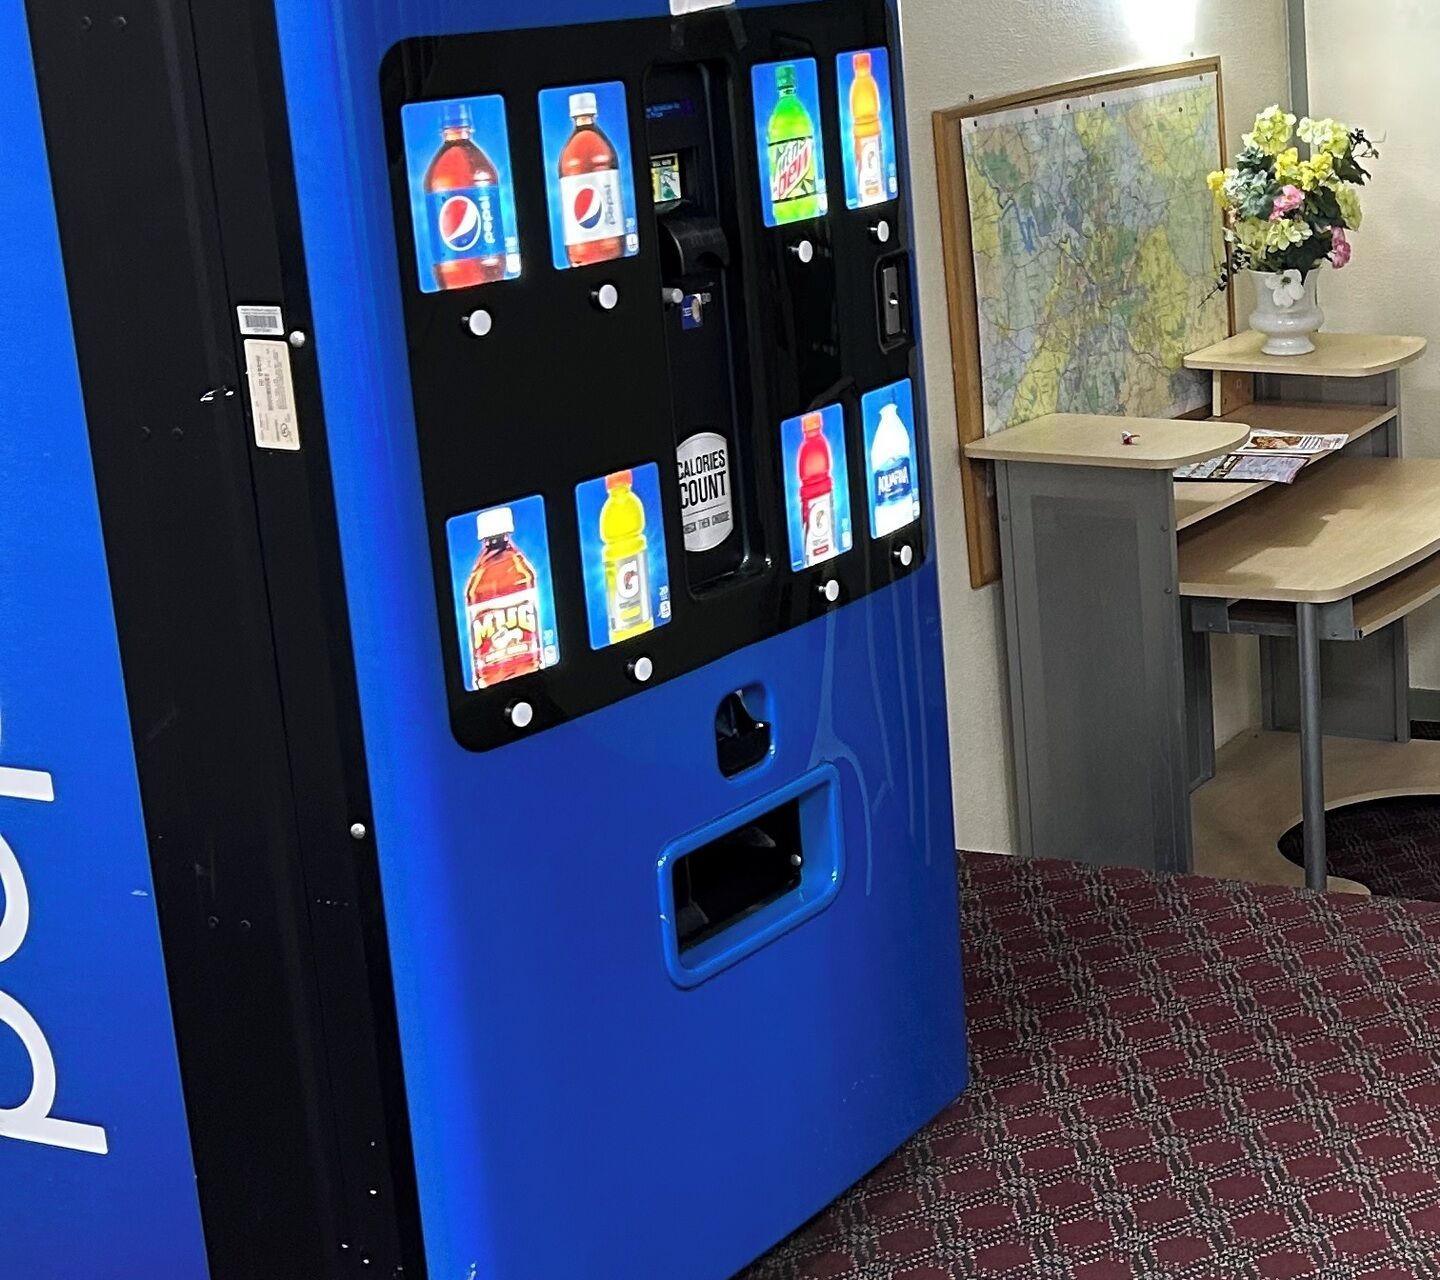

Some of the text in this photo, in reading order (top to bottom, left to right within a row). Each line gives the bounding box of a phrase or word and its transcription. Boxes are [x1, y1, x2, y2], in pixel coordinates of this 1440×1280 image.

[478, 195, 496, 244] pepsi
[678, 449, 726, 481] CALORIES
[680, 470, 727, 509] COUNT
[472, 605, 536, 649] MUG
